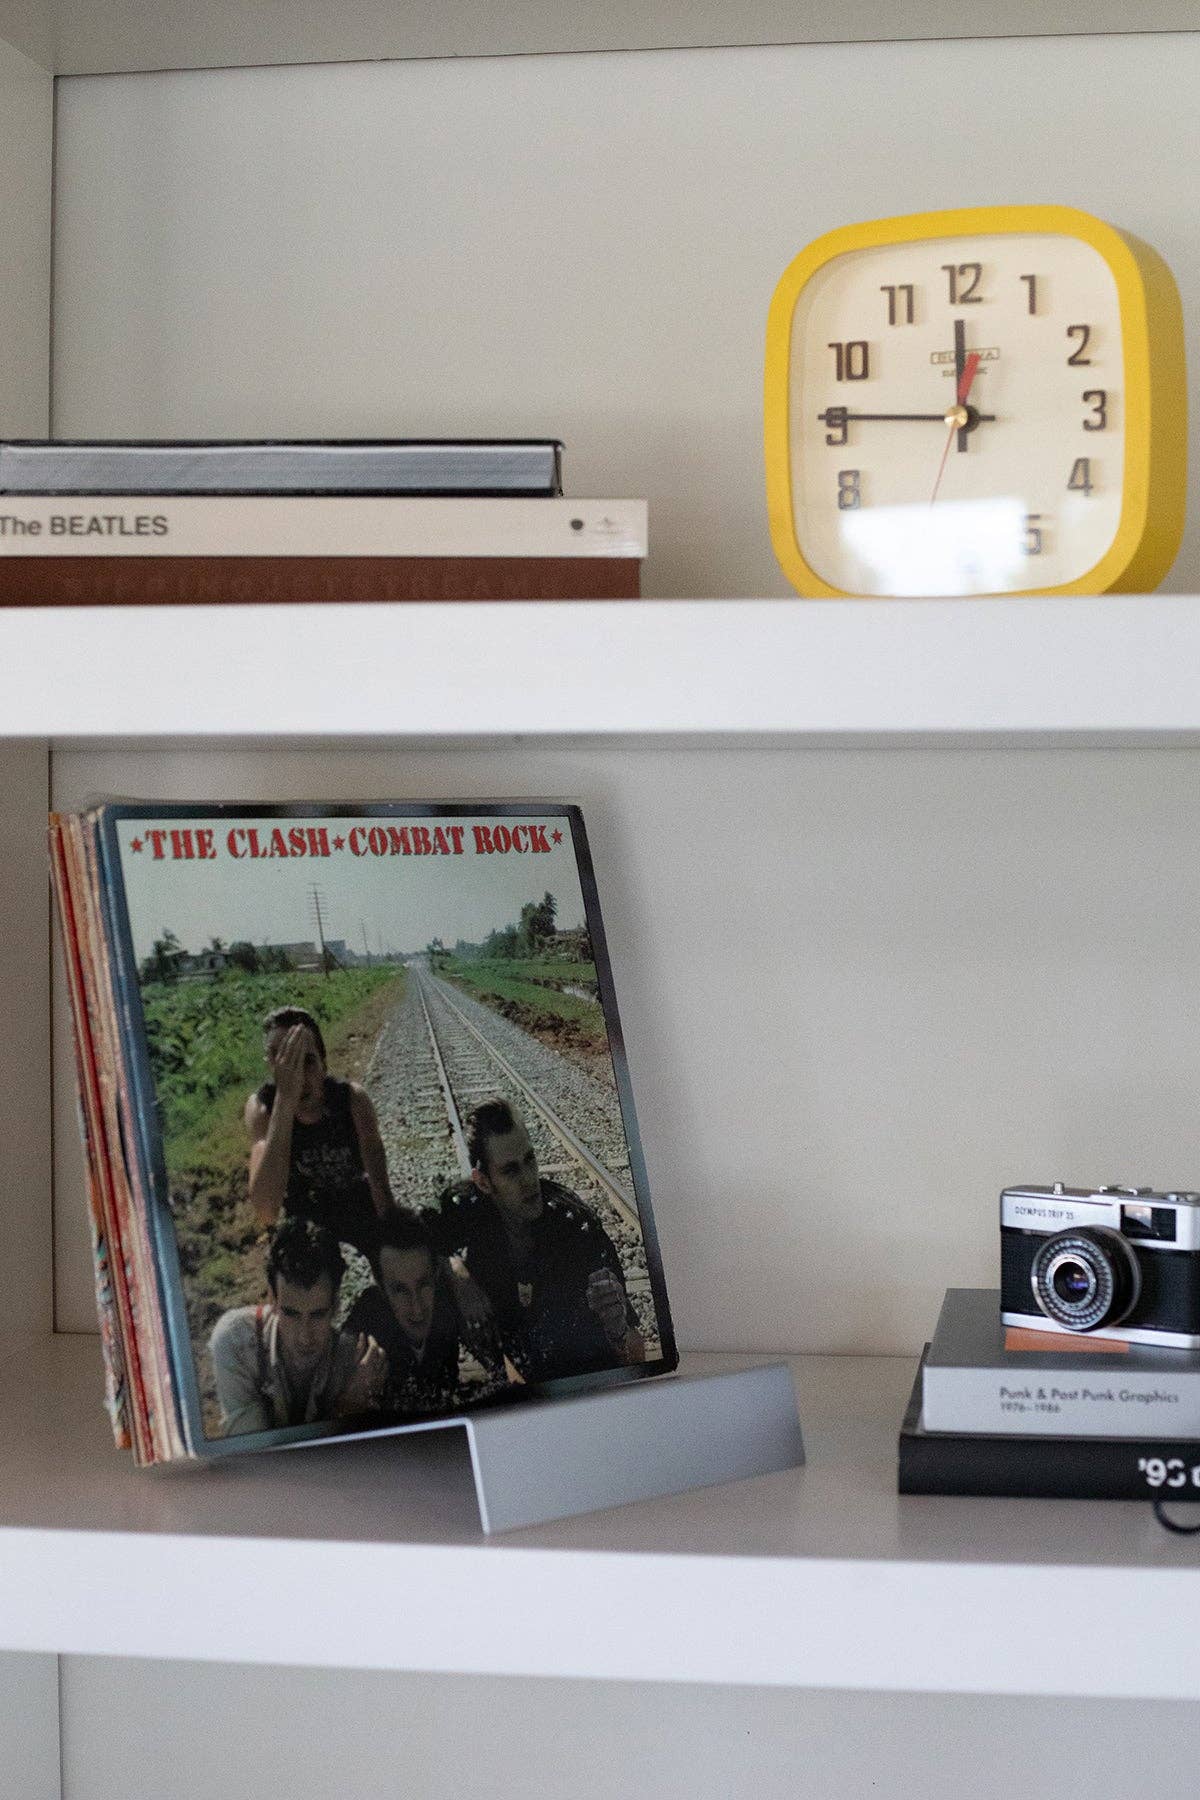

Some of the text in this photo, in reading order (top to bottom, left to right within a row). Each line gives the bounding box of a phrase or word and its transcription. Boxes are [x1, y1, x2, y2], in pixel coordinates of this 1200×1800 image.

[941, 262, 984, 305] 12
[1020, 274, 1037, 315] 1
[880, 284, 915, 326] 11
[828, 341, 870, 382] 10
[1067, 324, 1092, 367] 2
[824, 406, 848, 446] 9
[1082, 389, 1108, 432] 3
[838, 469, 861, 511] 8
[1067, 457, 1094, 497] 4
[0, 515, 169, 536] The BEATLES
[1022, 515, 1043, 555] 5
[144, 825, 552, 860] THE CLASH COMBAT ROCK
[1014, 1205, 1047, 1219] OLYMPUS
[1000, 1386, 1179, 1405] Punk & Post Punk Graphics
